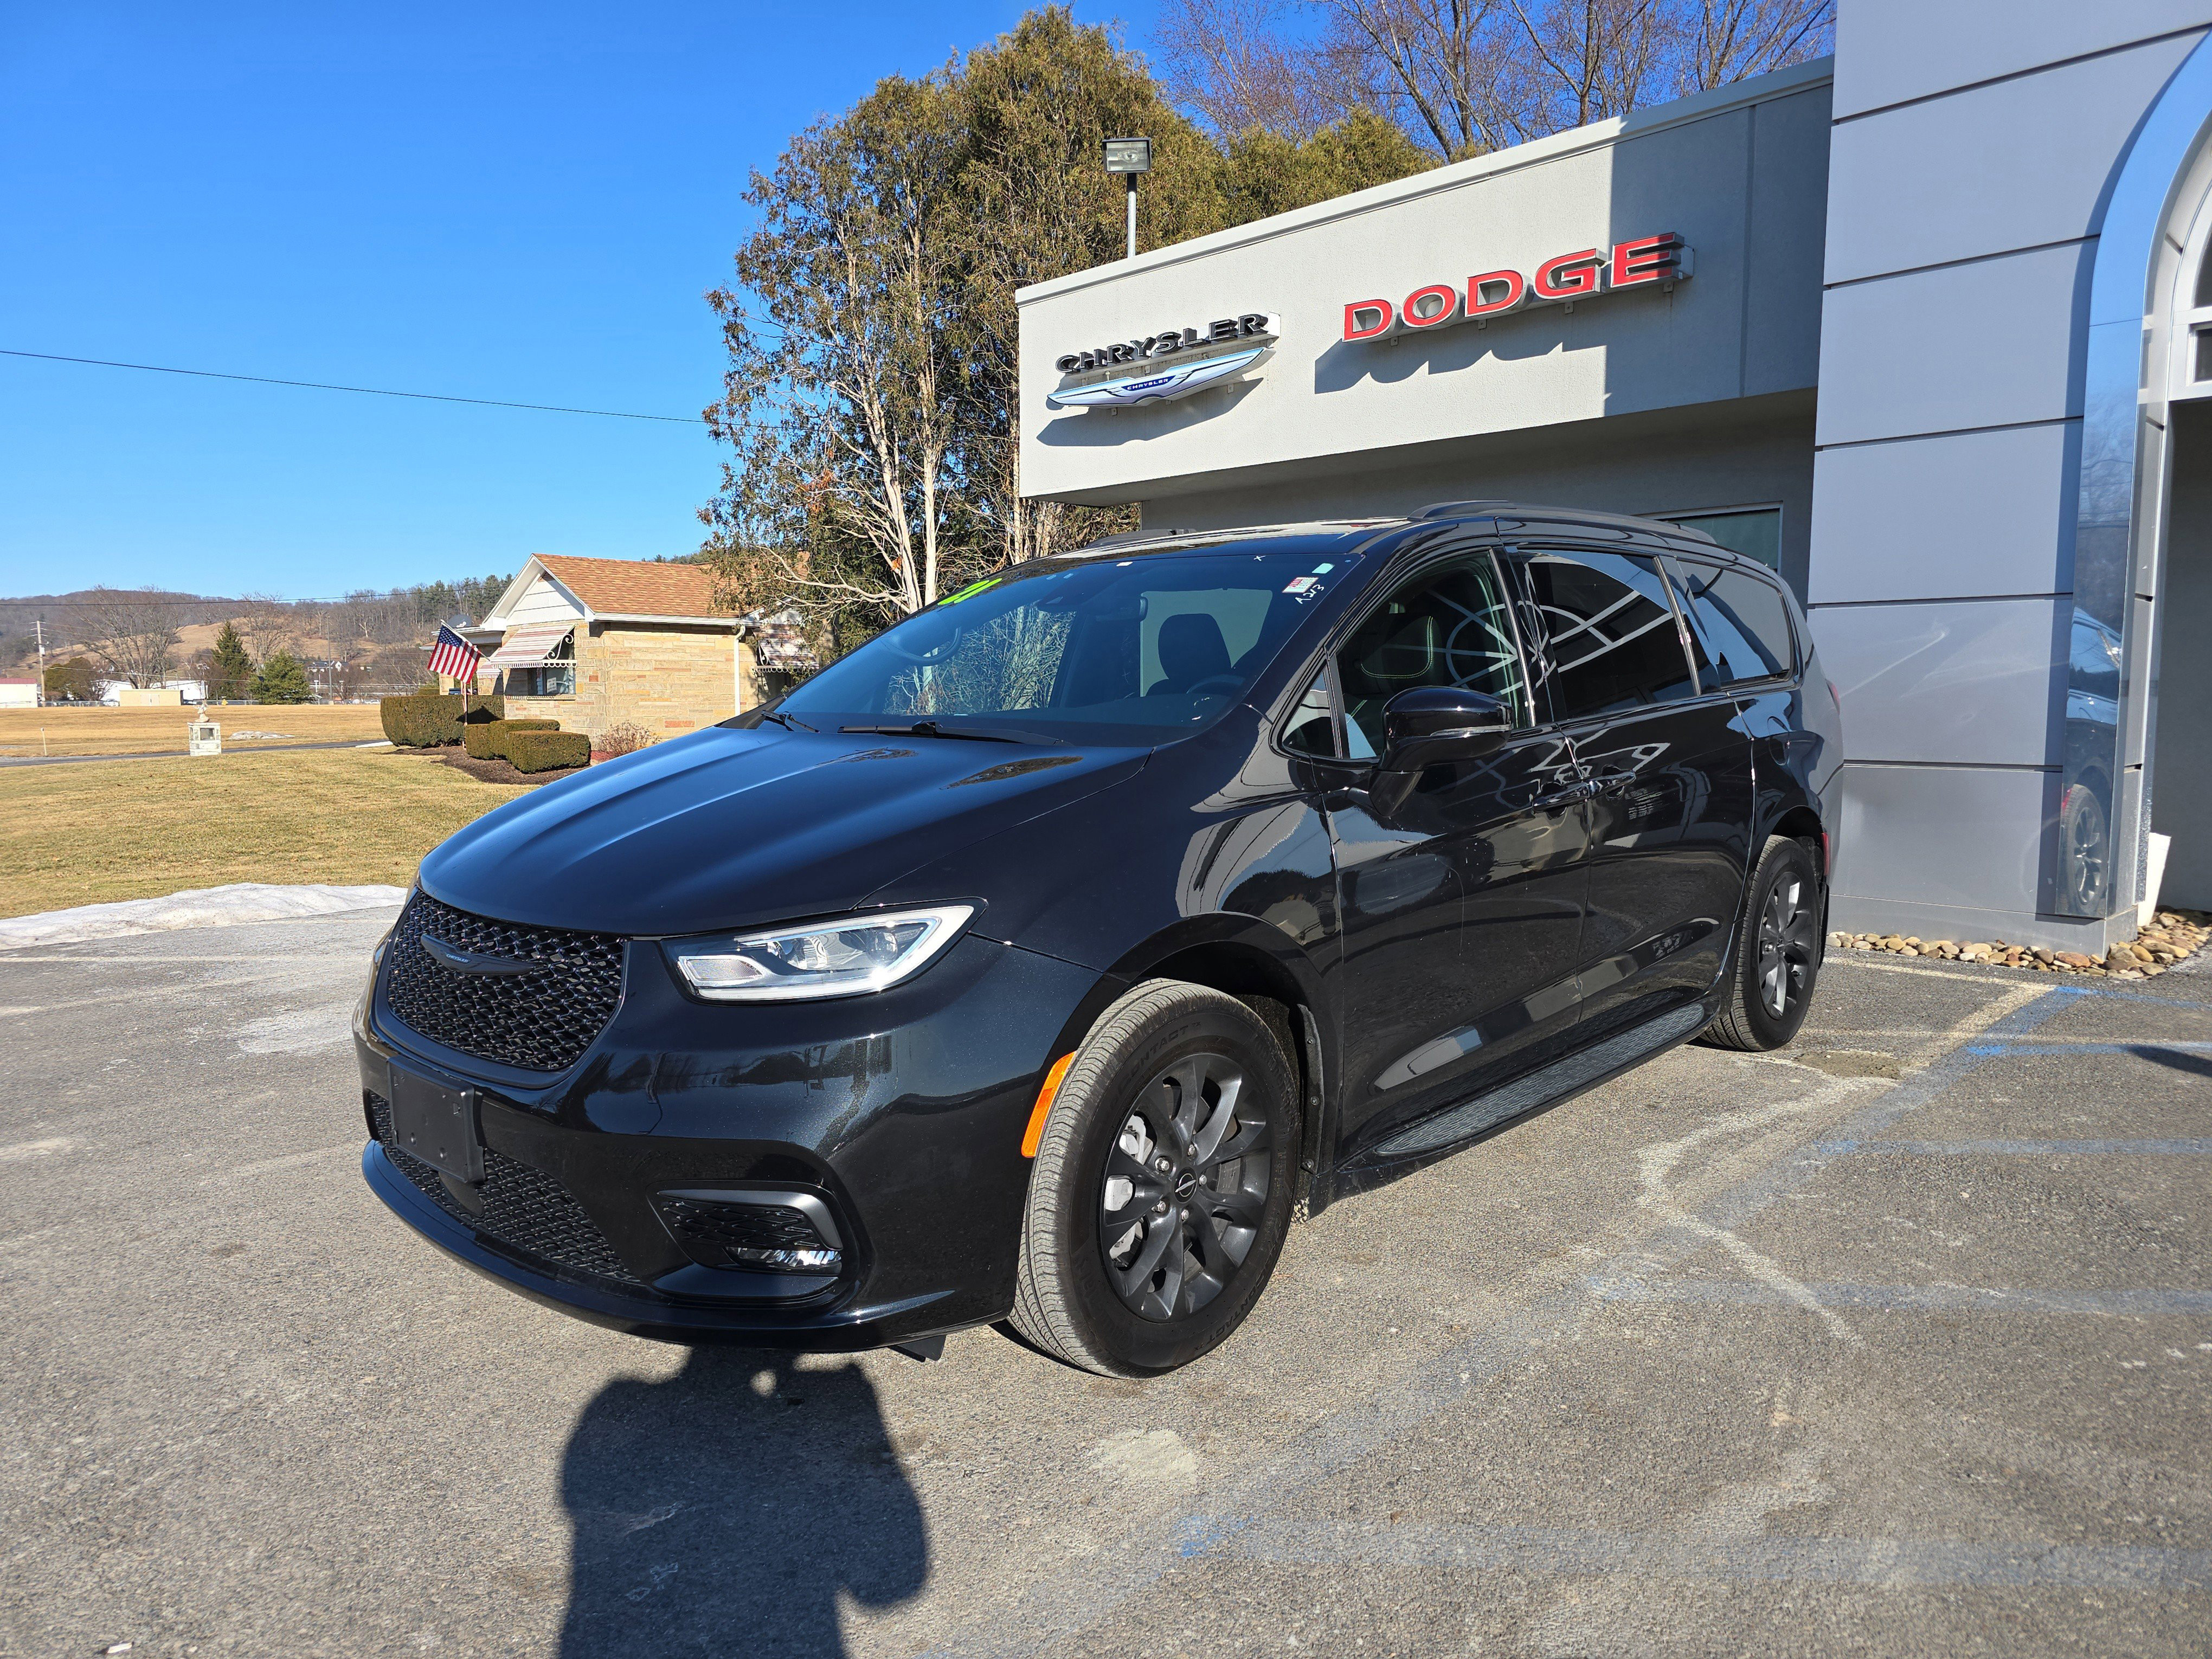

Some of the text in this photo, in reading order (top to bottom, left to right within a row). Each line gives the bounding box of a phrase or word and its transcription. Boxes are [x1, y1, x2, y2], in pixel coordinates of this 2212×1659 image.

[1342, 232, 1683, 342] DODGE
[1056, 314, 1268, 373] CHRYSLER
[1127, 378, 1168, 390] CHRYSLER
